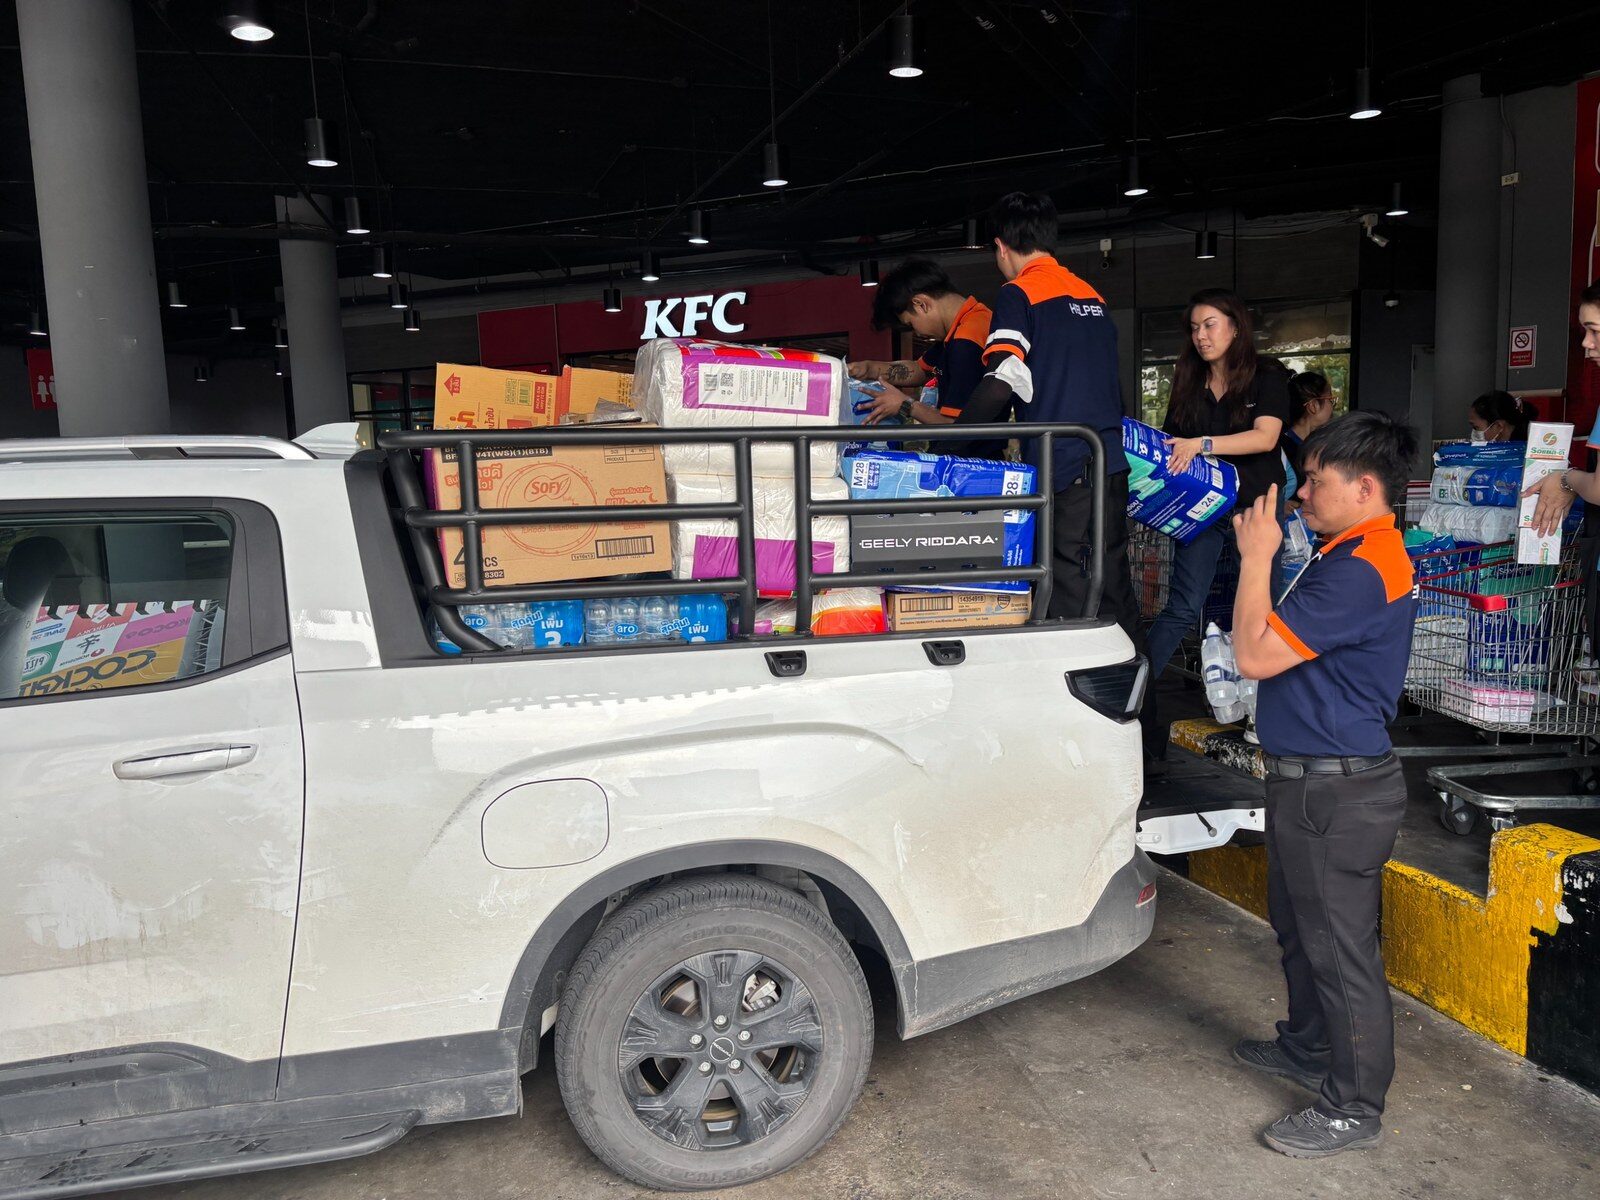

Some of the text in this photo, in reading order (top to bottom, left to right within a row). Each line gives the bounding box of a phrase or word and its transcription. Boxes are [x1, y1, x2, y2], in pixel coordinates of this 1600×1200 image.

[640, 291, 746, 340] KFC
[1069, 302, 1104, 317] HELPER
[853, 462, 865, 487] M 28
[532, 479, 562, 495] SOFY
[1201, 496, 1215, 508] 24
[861, 534, 995, 549] GEELY RIDDARA
[483, 556, 498, 568] CS
[466, 617, 484, 626] aro
[541, 616, 564, 629] เพิ่ม
[688, 620, 709, 634] เพิ่ม
[617, 625, 635, 633] aro
